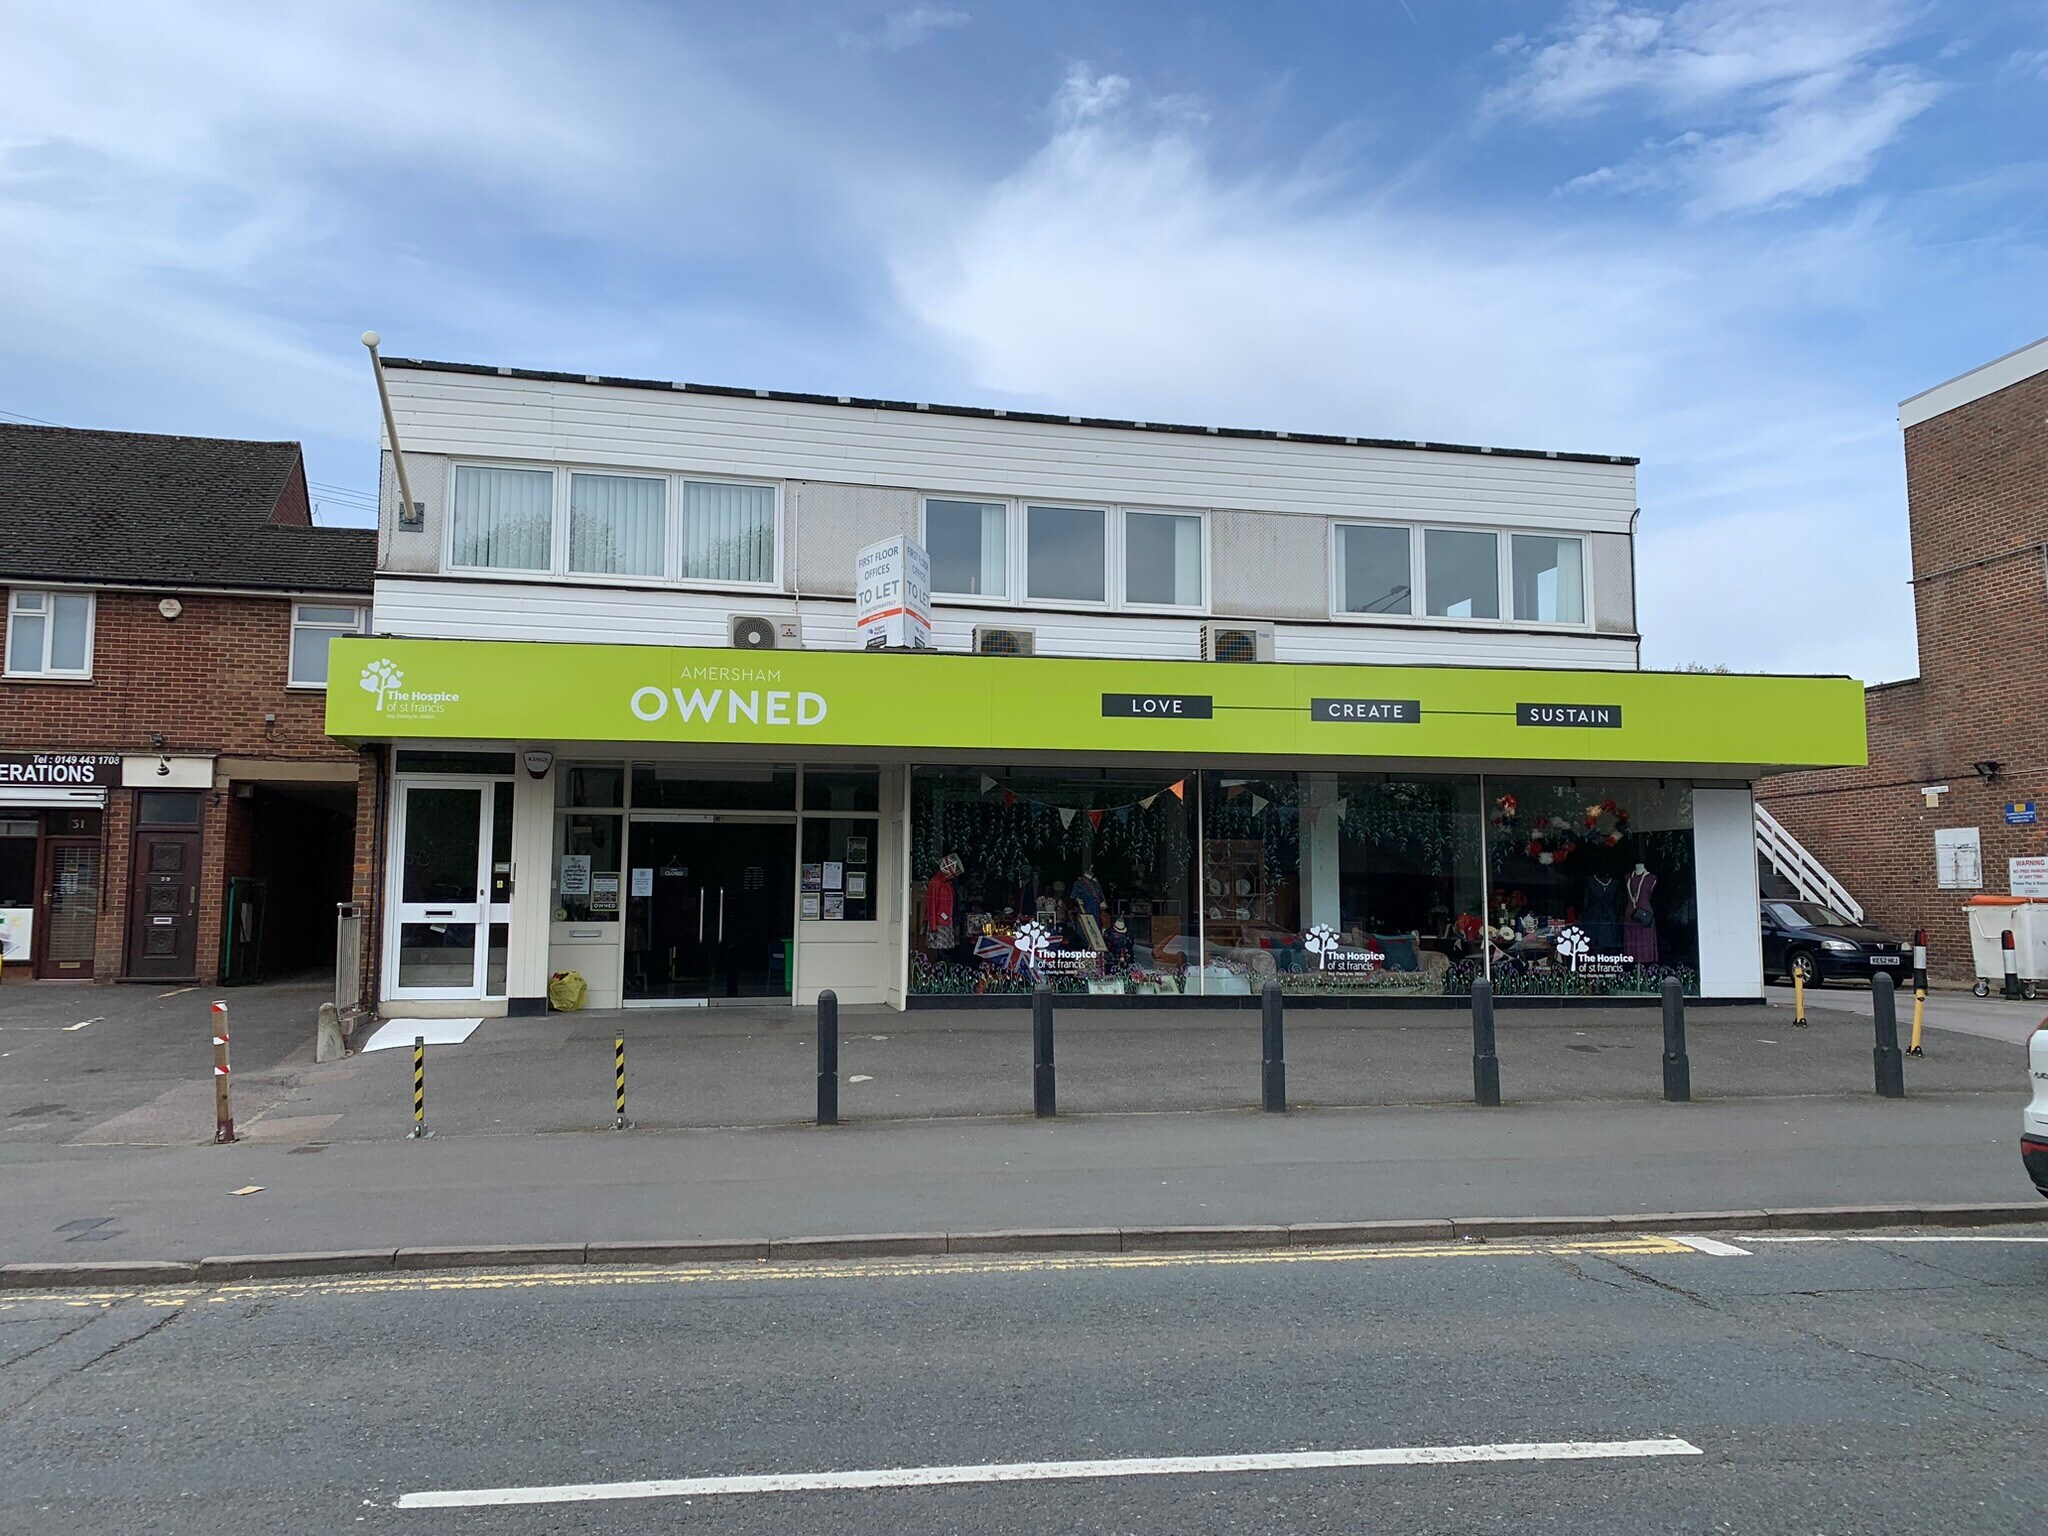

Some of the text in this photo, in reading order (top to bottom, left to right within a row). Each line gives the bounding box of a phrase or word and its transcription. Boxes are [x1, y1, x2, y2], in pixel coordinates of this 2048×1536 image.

[858, 546, 899, 569] FIRST FLOOR
[864, 563, 890, 580] OFFICES
[859, 580, 900, 607] TO LET
[907, 580, 918, 599] TO
[919, 588, 930, 610] LET
[681, 666, 781, 682] AMERSHAM
[387, 691, 459, 703] The Hospice
[387, 702, 445, 713] of st francis
[631, 686, 827, 725] OWNED
[1132, 699, 1183, 714] LOVE
[1329, 703, 1403, 718] CREATE
[1530, 708, 1609, 723] SUSTAIN
[55, 755, 77, 764] 0149
[79, 755, 96, 765] 443
[98, 756, 120, 765] 1708
[0, 764, 95, 782] ERATIONS
[72, 819, 85, 829] 31
[1037, 949, 1097, 960] The Hospice
[1327, 951, 1385, 962] The Hospice
[1578, 953, 1634, 964] The Hospice
[1037, 959, 1085, 968] of st francis
[1327, 961, 1374, 970] of st francis
[1579, 963, 1624, 972] of st francis
